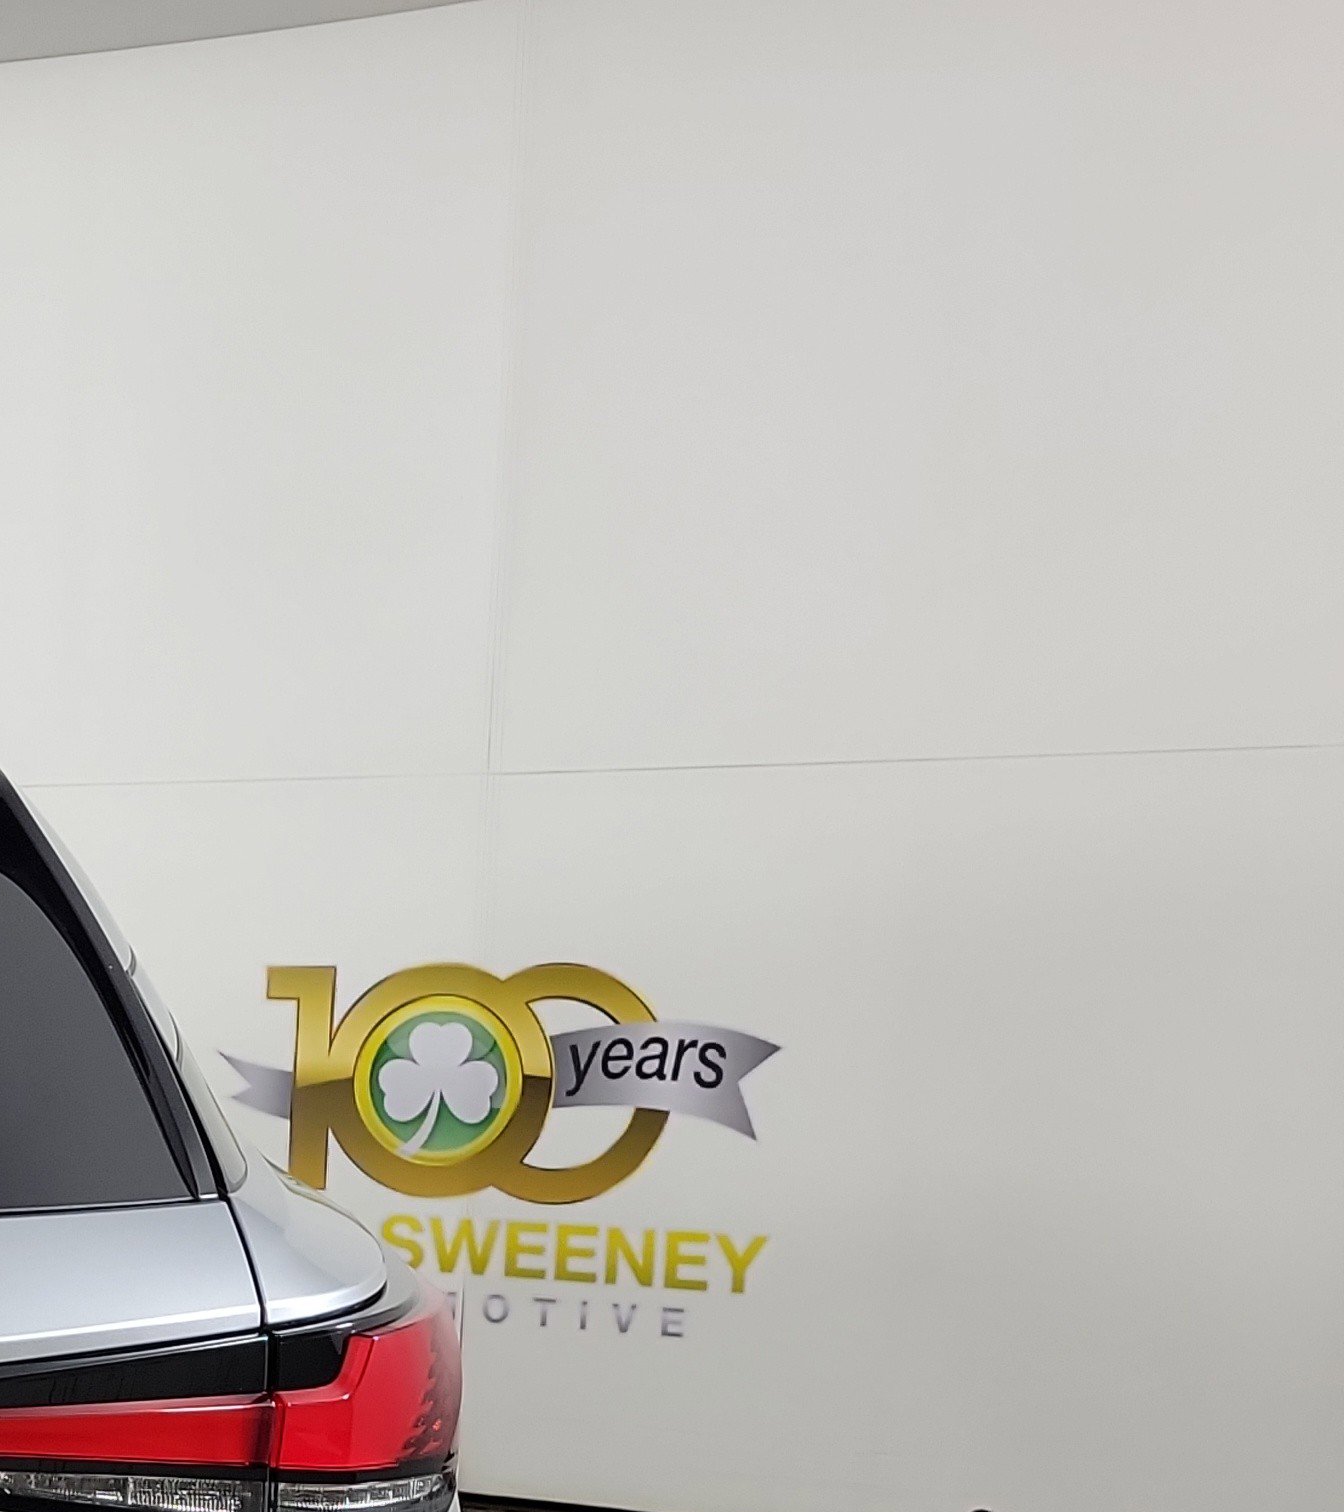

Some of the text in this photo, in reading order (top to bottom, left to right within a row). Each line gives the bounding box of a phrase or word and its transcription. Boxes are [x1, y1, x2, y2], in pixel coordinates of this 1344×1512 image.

[266, 962, 728, 1205] 100 years
[380, 1214, 768, 1294] SWEENEY
